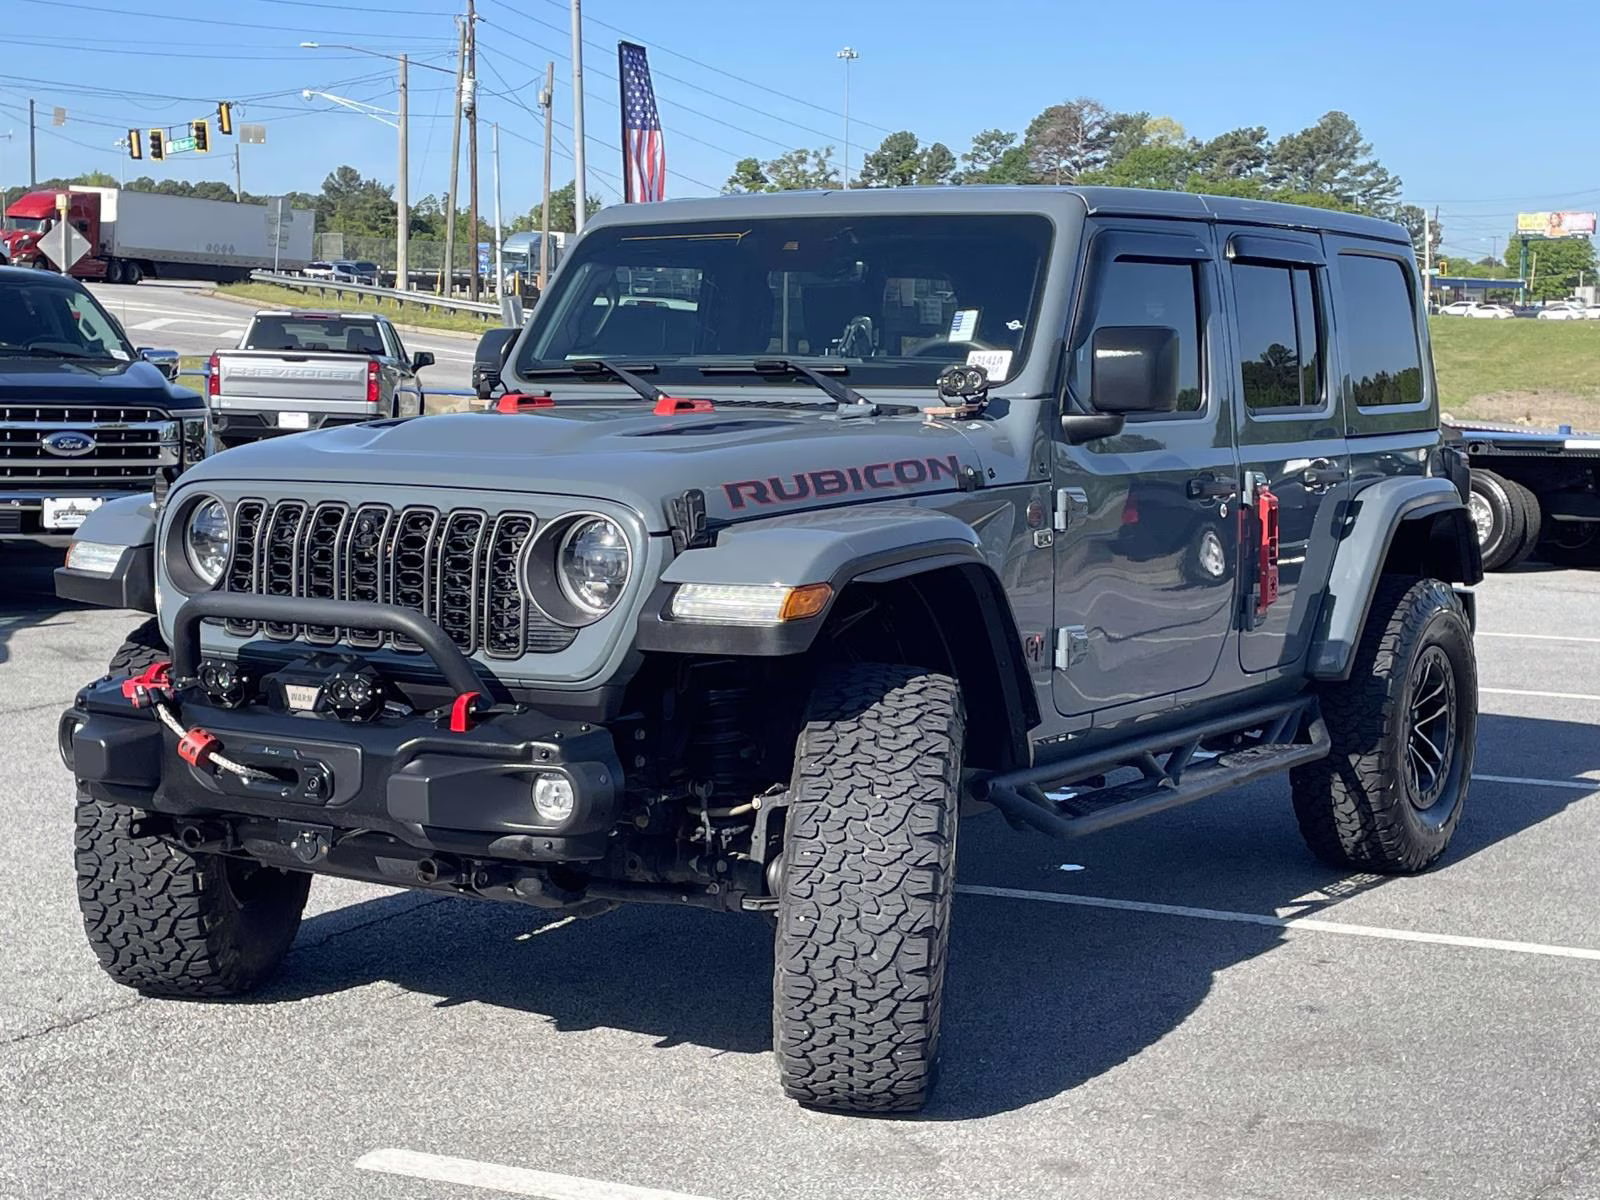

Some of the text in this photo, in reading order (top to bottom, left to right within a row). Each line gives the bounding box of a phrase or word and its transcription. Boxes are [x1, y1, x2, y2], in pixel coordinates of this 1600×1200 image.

[229, 367, 356, 380] CHEVROLET
[58, 438, 83, 449] Ford
[721, 455, 959, 511] RUBICON
[291, 693, 312, 702] WARN
